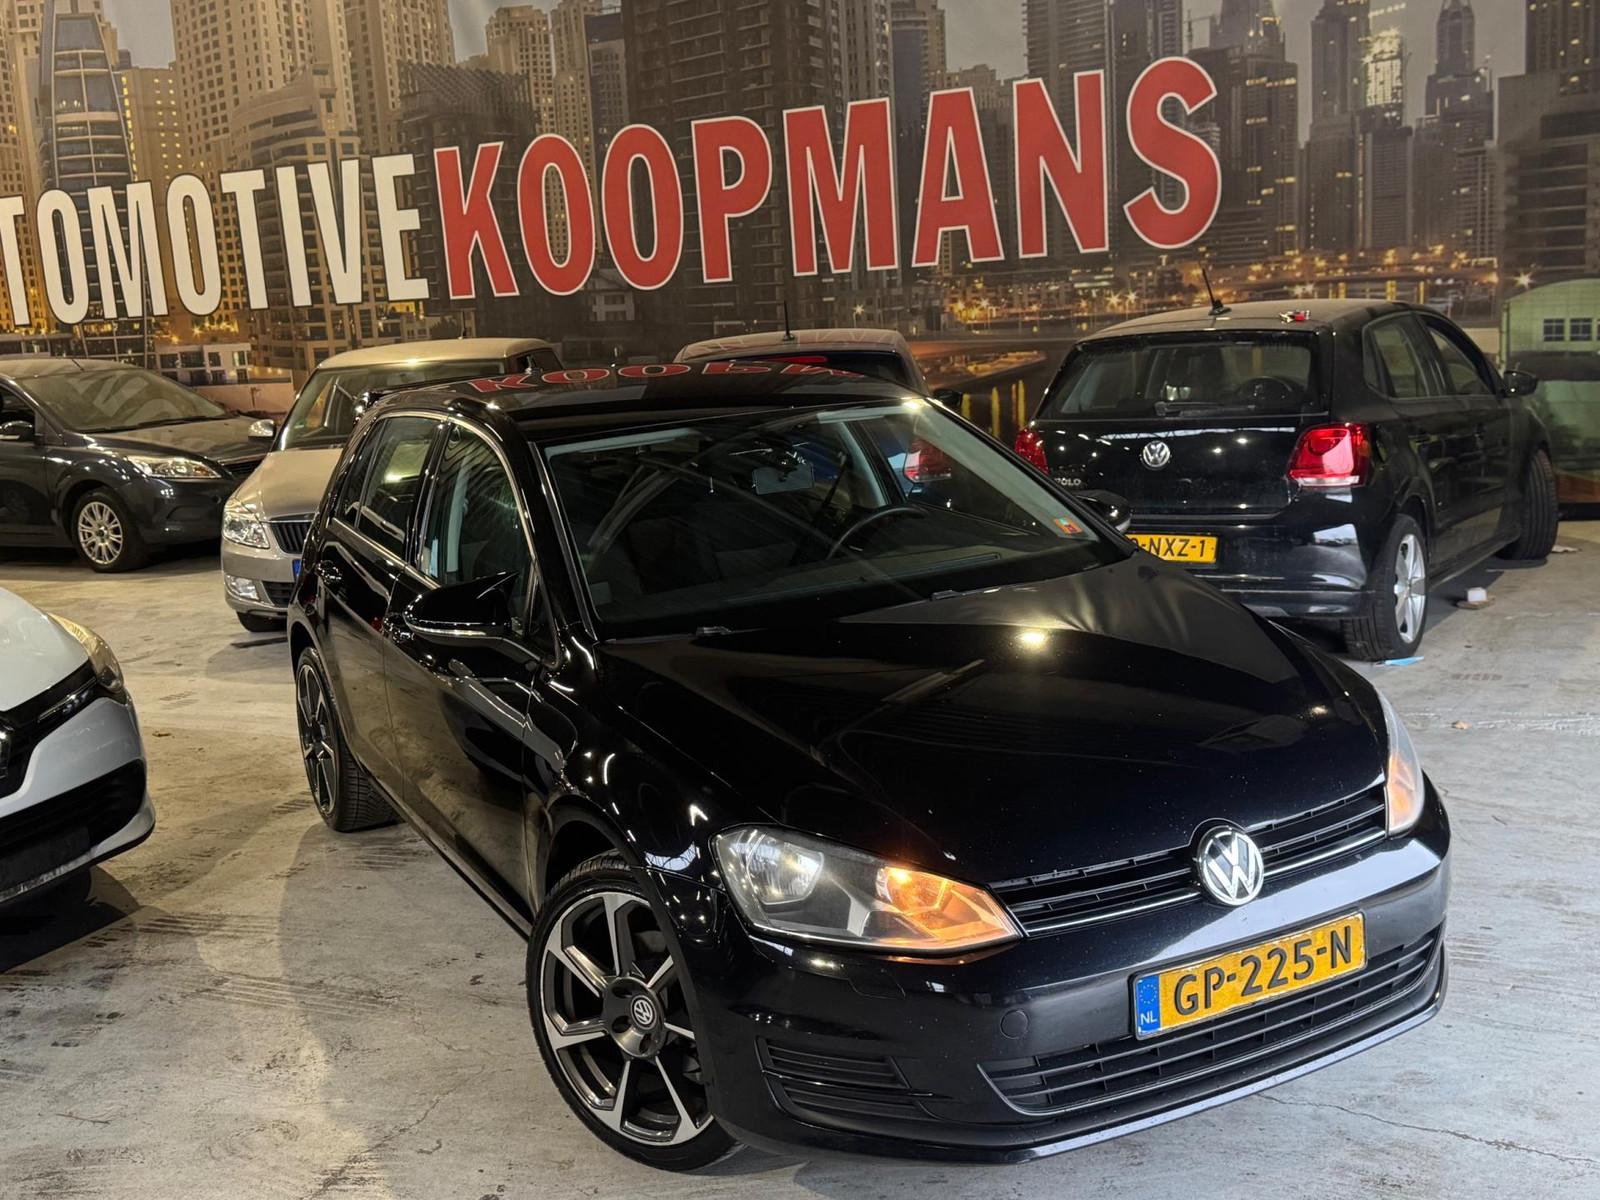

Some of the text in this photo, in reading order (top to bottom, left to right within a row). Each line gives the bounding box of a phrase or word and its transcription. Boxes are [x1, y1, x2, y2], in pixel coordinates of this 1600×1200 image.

[0, 57, 1222, 326] TOMOTIVE KOOPMANS
[1201, 827, 1264, 904] VW
[1174, 925, 1352, 1015] GP-225-N
[1140, 1010, 1157, 1025] NL
